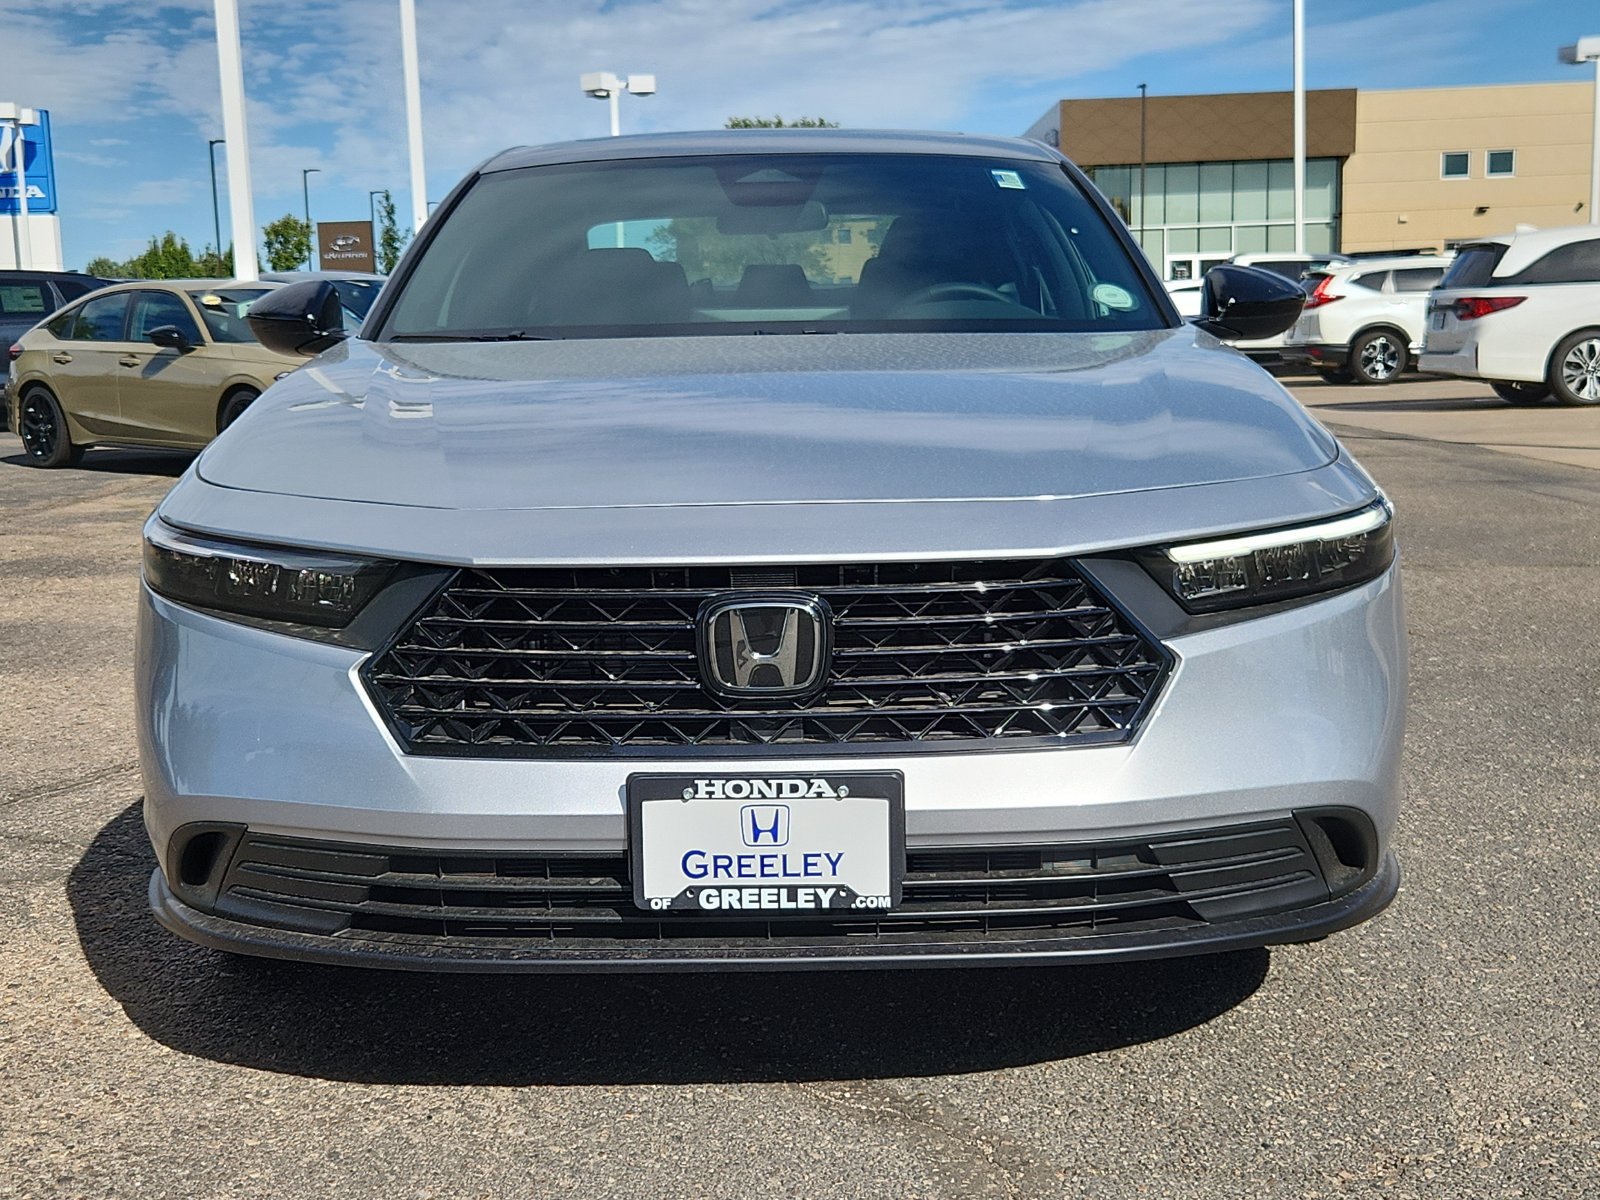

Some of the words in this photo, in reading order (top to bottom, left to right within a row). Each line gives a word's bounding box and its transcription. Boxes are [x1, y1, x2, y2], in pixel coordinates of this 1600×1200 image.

[693, 779, 838, 799] HONDA
[681, 849, 845, 879] GREELEY
[650, 898, 672, 910] OF
[698, 887, 838, 909] GREELEY
[850, 895, 892, 909] .COM
